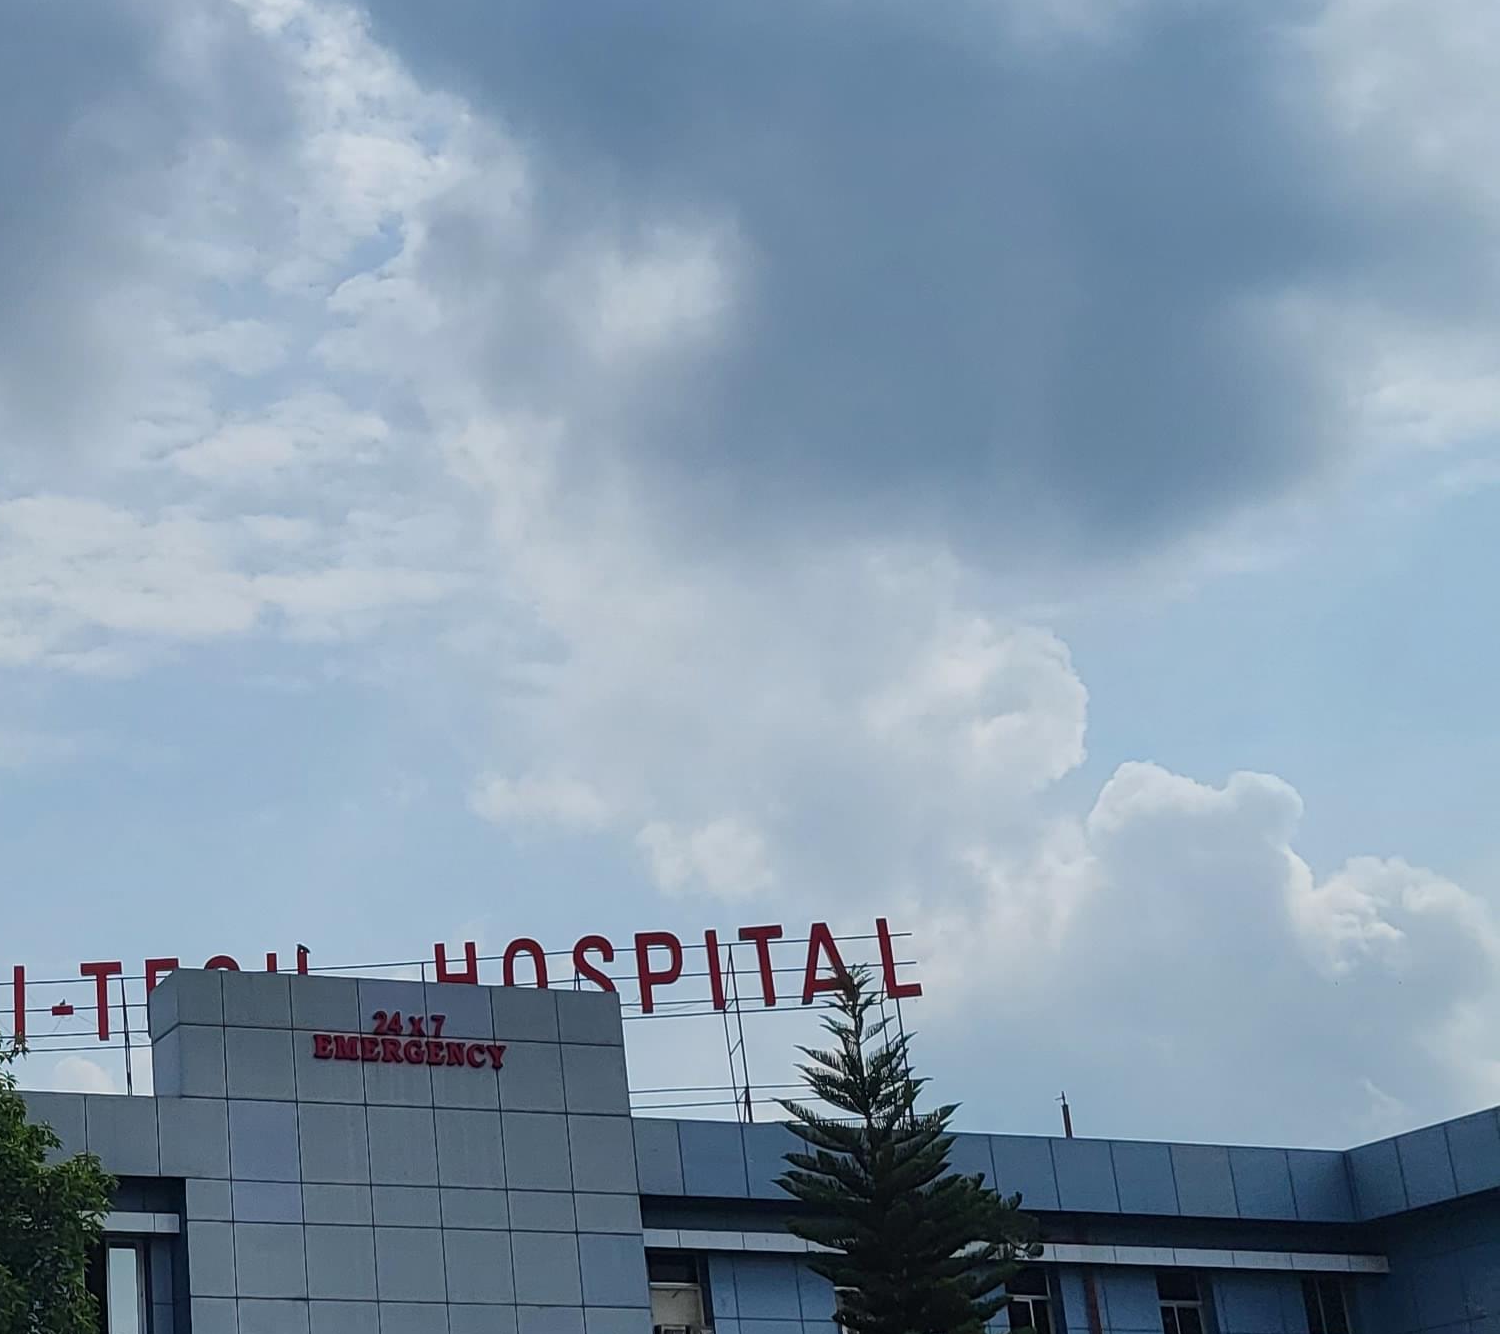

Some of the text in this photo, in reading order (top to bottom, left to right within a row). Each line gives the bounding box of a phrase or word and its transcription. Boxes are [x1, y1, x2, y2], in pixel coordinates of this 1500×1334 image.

[372, 1010, 404, 1035] 24
[430, 1014, 447, 1038] 7
[313, 1034, 507, 1069] EMERGENCY
